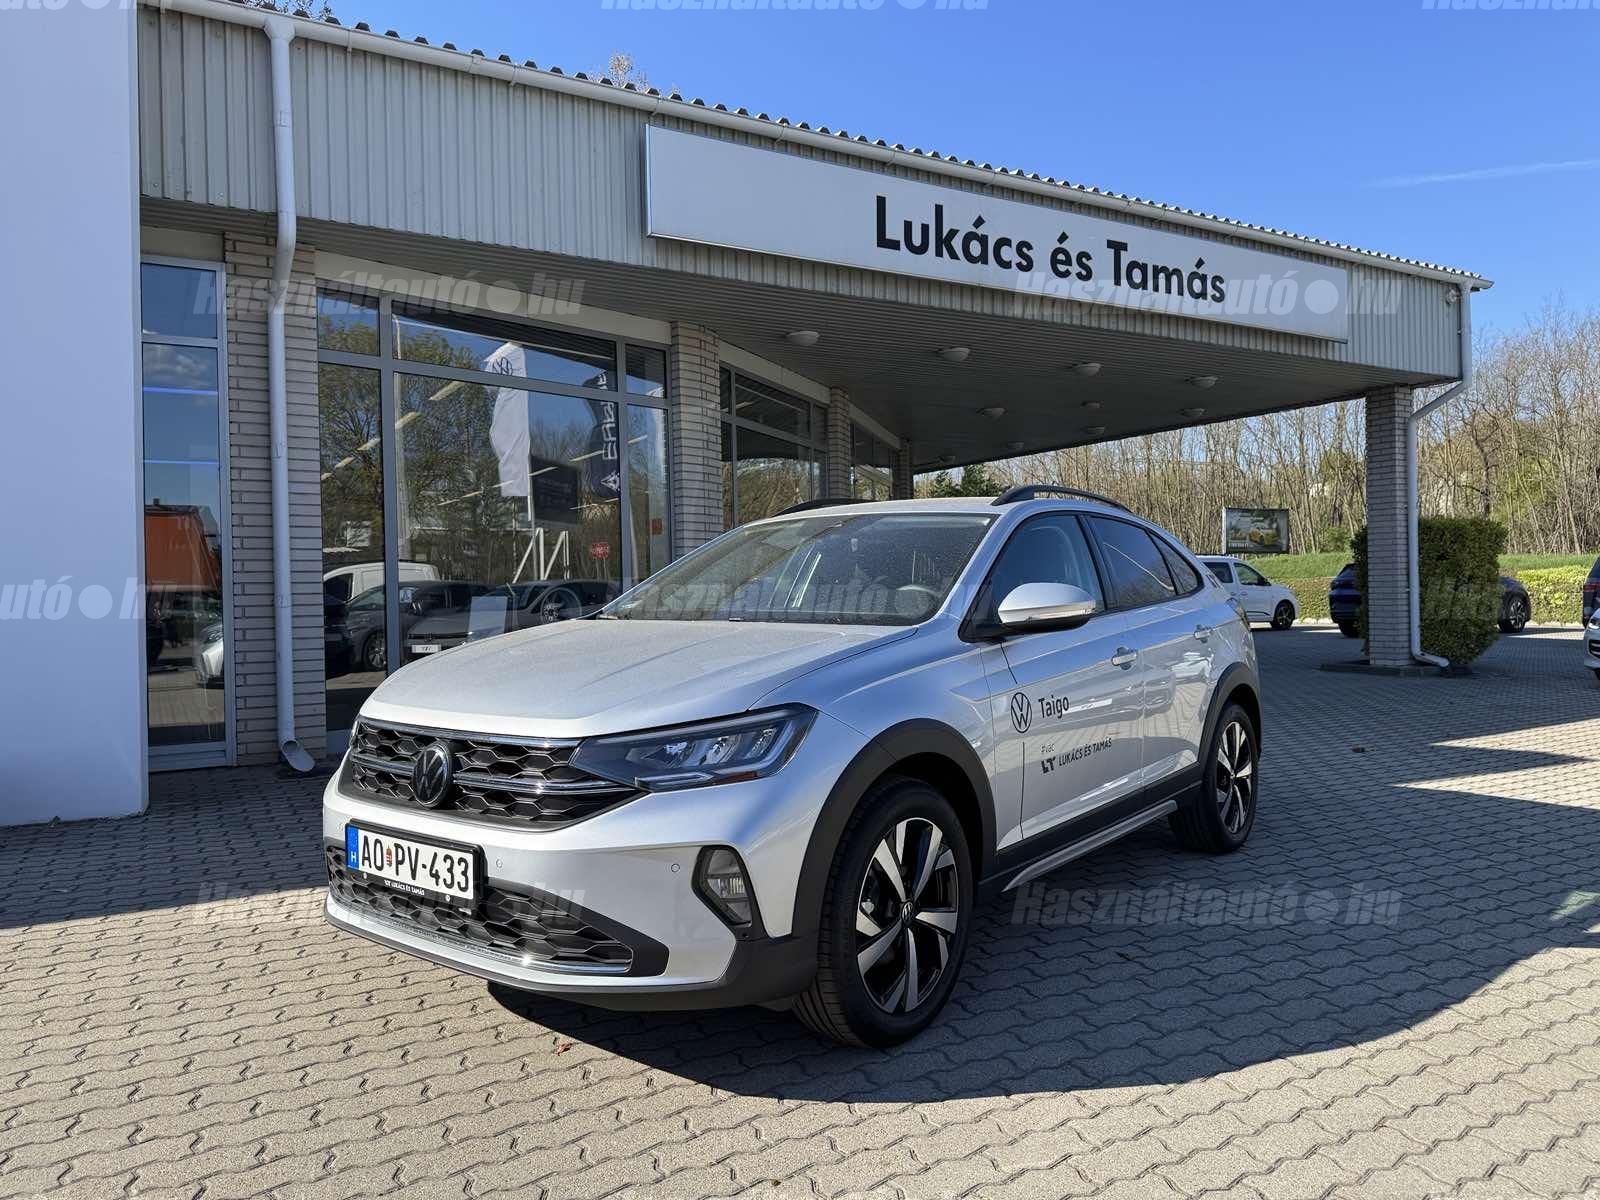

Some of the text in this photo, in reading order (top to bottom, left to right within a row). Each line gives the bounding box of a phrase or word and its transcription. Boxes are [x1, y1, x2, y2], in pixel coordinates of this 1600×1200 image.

[875, 195, 1226, 303] Lukács és Tamás
[1038, 694, 1069, 719] Taigo
[1059, 748, 1082, 766] LUKÁCS
[350, 835, 469, 892] H AO PV-433
